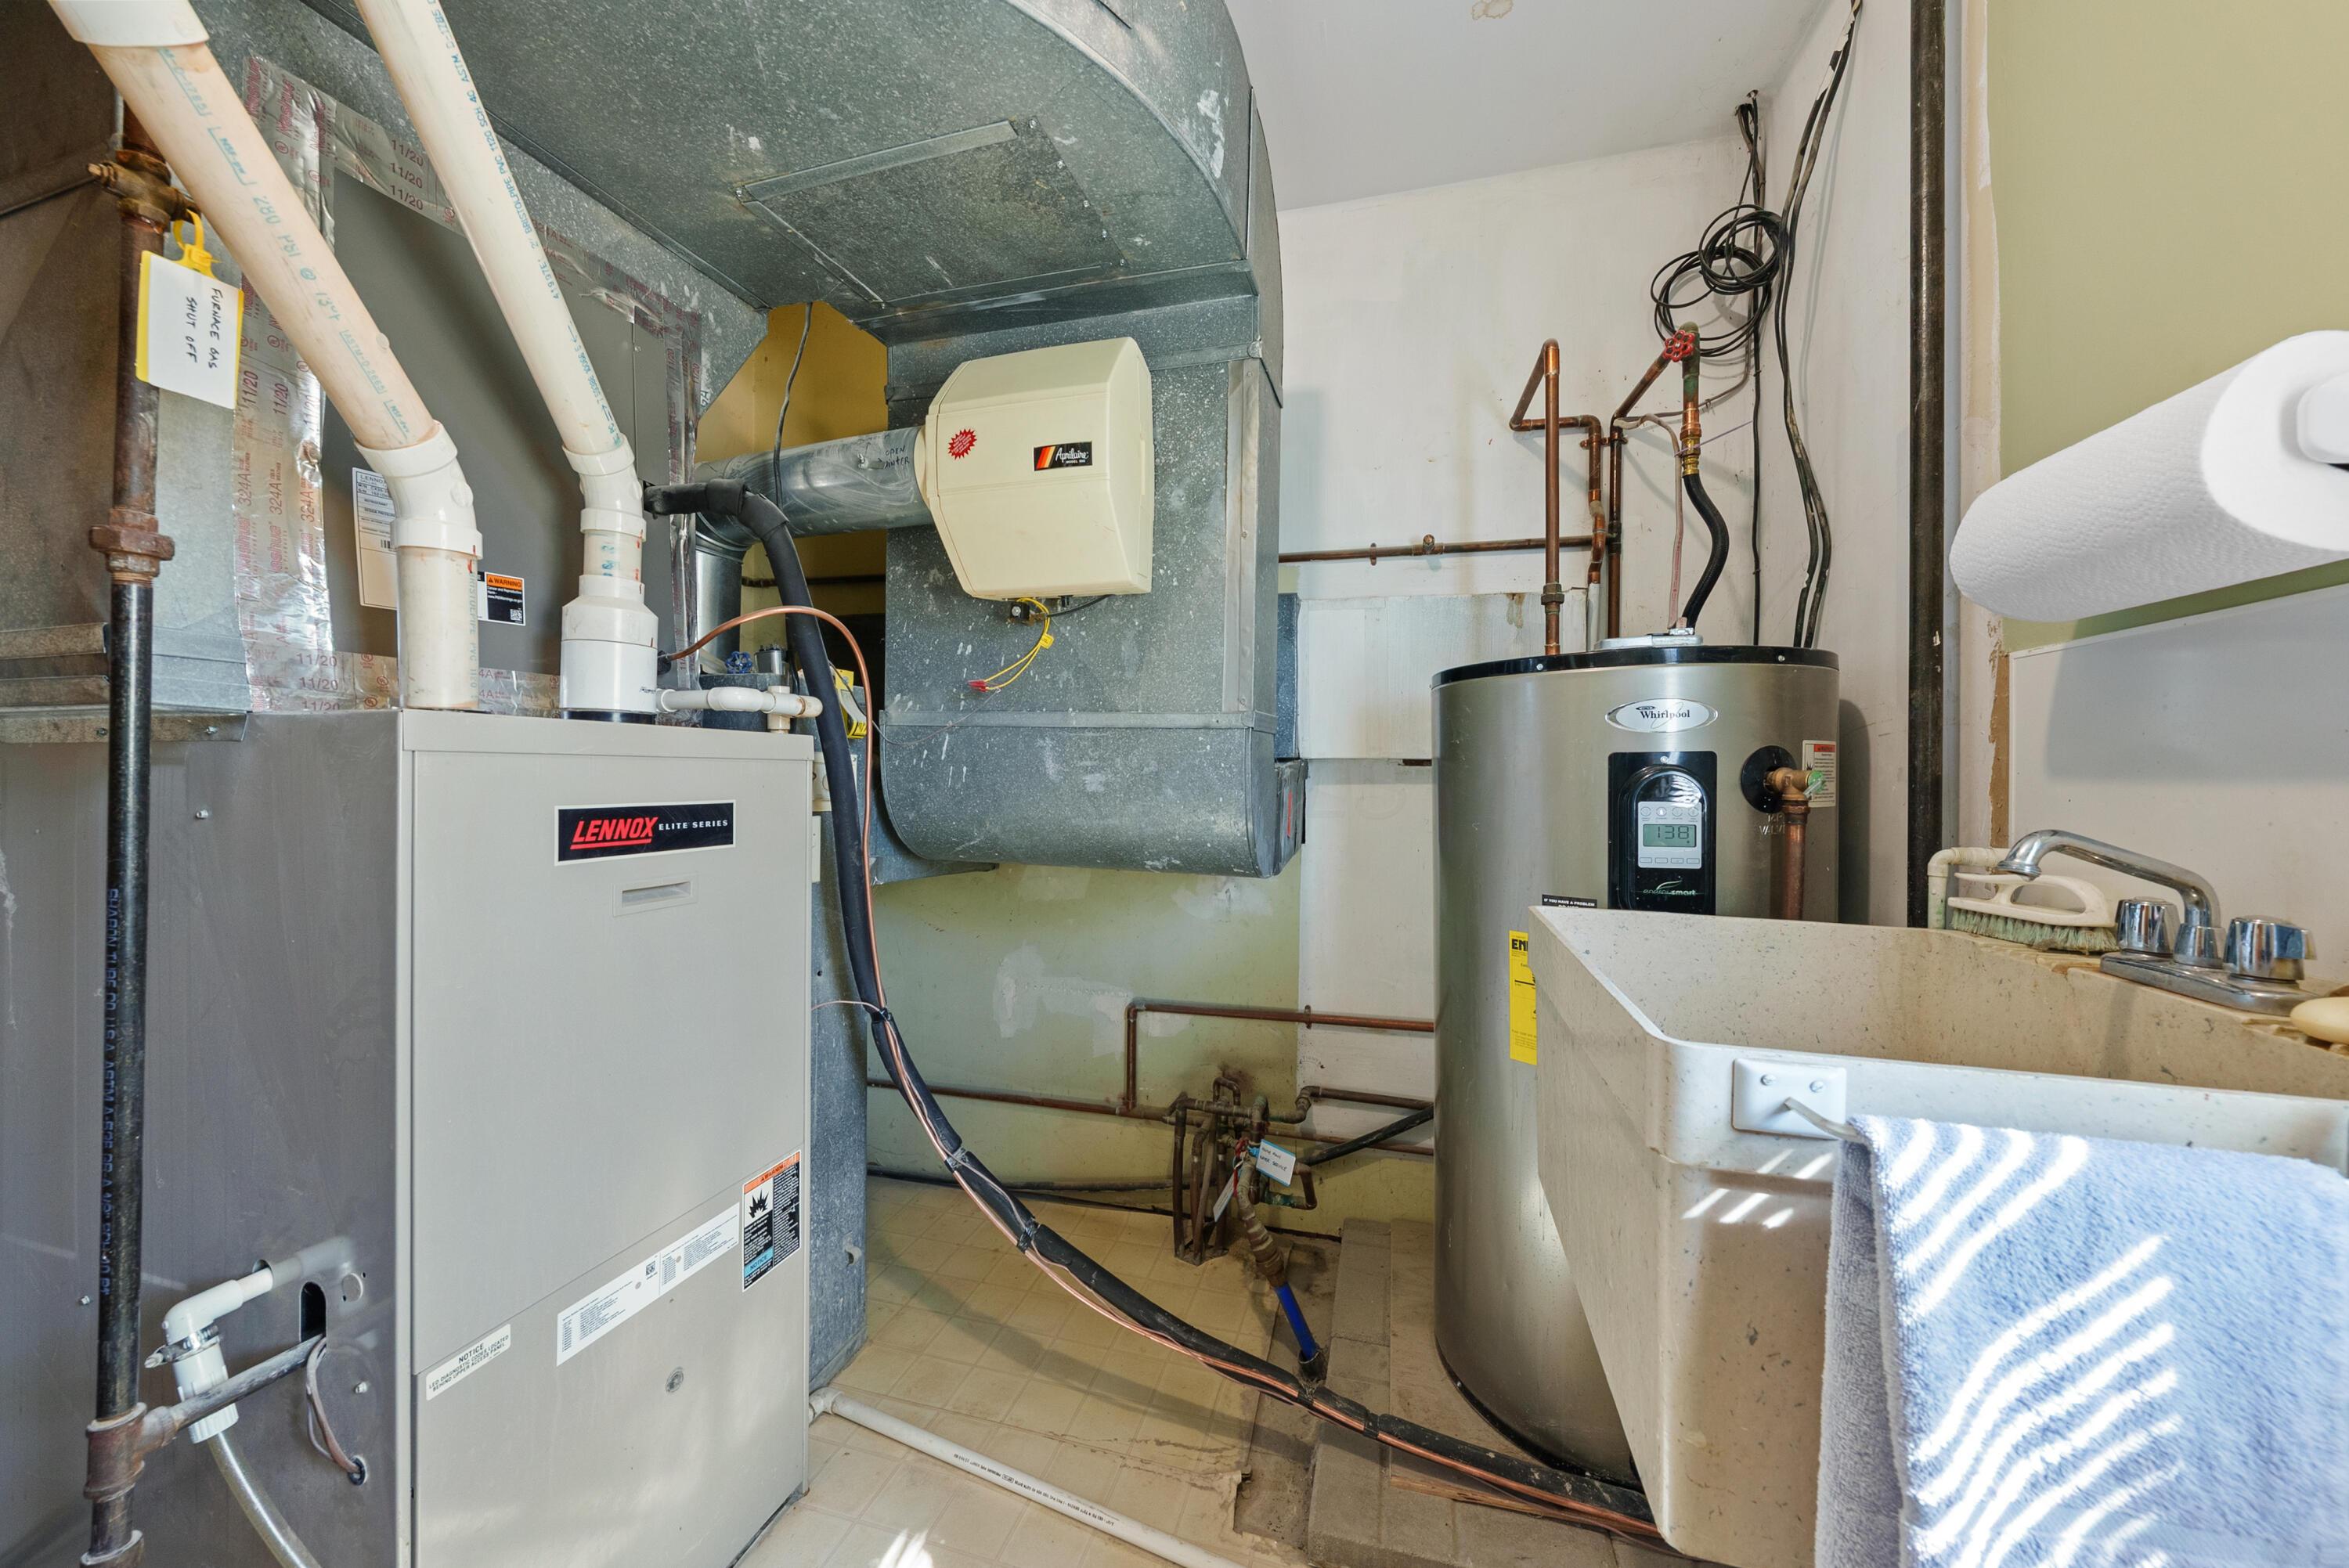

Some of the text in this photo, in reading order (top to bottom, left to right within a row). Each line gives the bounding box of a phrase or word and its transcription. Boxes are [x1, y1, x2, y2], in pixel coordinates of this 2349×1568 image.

[474, 107, 488, 128] SCH
[392, 140, 424, 167] 11/20
[495, 155, 506, 174] PVC
[391, 163, 423, 189] 11/20
[391, 186, 424, 210] 11/20
[210, 287, 223, 341] FURNACE
[186, 297, 197, 363] SHUT OFF
[242, 370, 258, 409] 11/20
[273, 384, 289, 415] 11/20
[1055, 447, 1089, 463] Aprilaire
[238, 474, 251, 506] 324A
[269, 483, 282, 515] 324A
[494, 578, 521, 588] WARNING
[297, 653, 337, 666] 11/20
[299, 677, 339, 690] 11/20
[1640, 709, 1690, 720] Whirlpool
[572, 816, 728, 843] LENNOX ELITE SERIES
[1657, 825, 1690, 839] 138
[750, 1254, 767, 1271] NOTICE
[428, 1379, 438, 1390] LED
[488, 1335, 509, 1351] LOCATED
[458, 1343, 484, 1364] NOTICE
[471, 1352, 489, 1366] ACCESS
